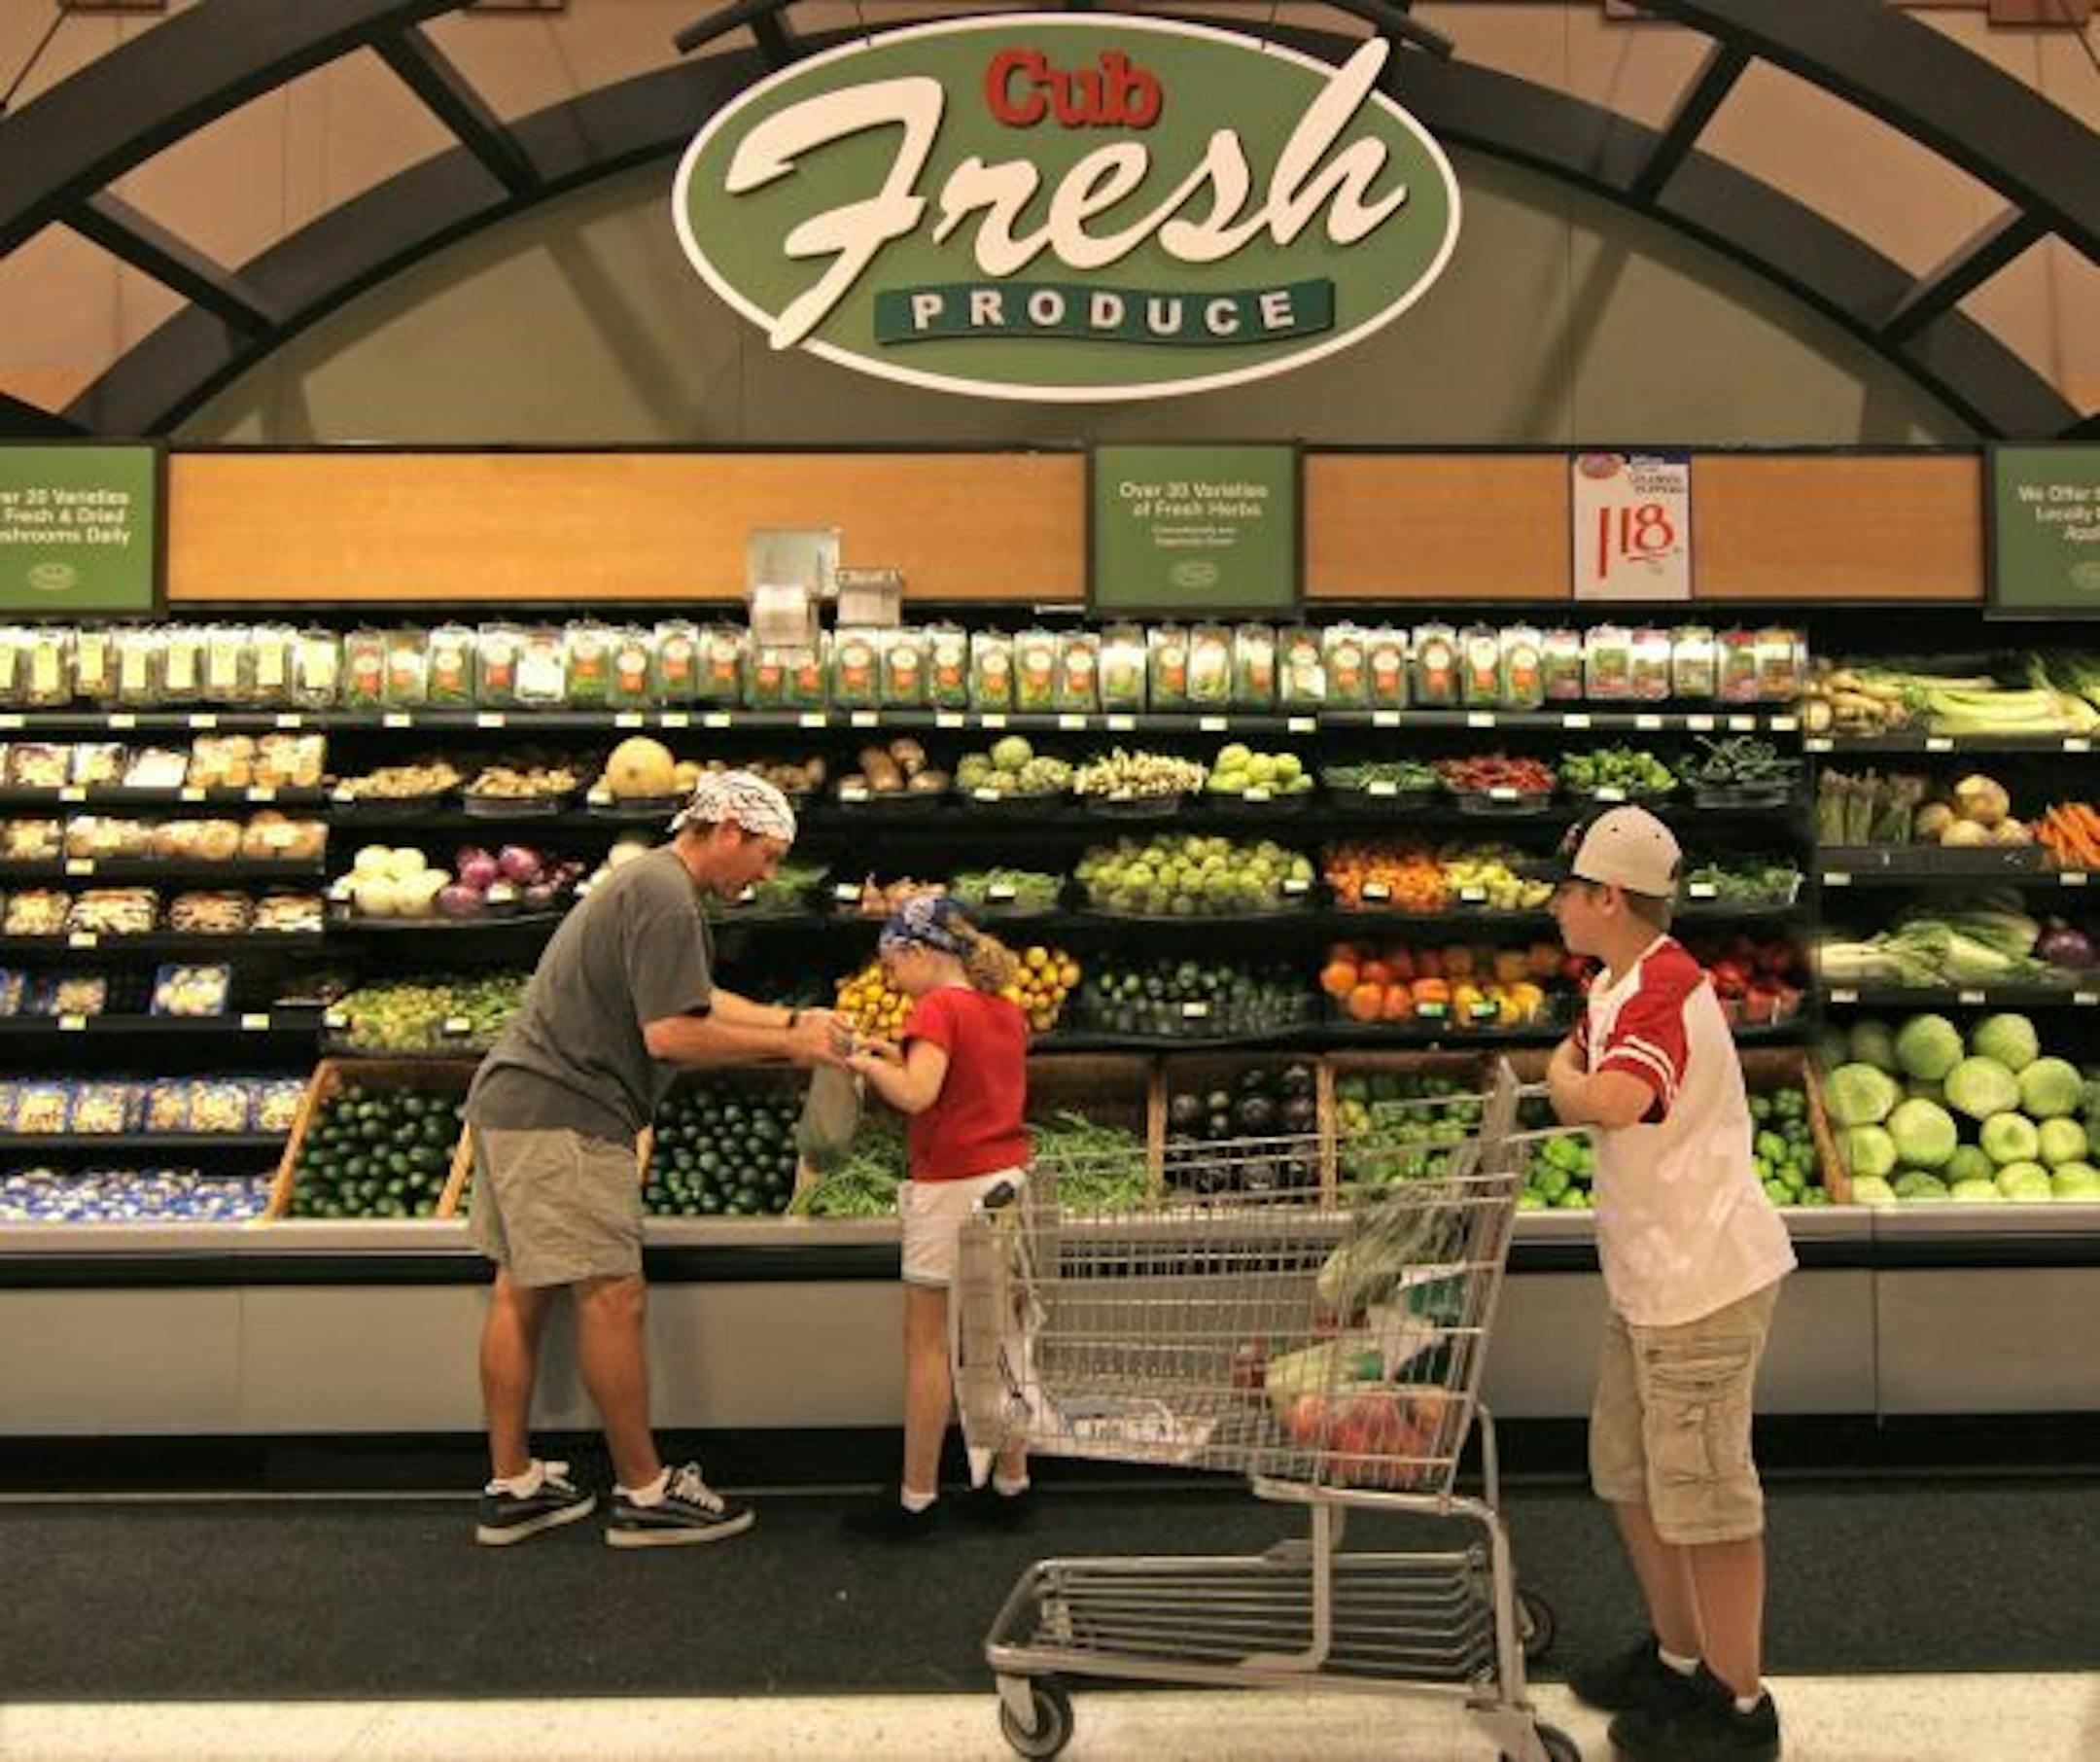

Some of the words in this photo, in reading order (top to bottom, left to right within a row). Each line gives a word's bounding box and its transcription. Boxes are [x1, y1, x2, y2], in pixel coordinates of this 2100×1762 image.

[984, 49, 1163, 129] Cub
[725, 36, 1408, 351] Fresh
[912, 291, 1296, 335] PRODUCE
[0, 492, 19, 504] er
[52, 489, 129, 505] Varieties
[1119, 481, 1162, 498] Over
[1194, 481, 1268, 498] Varieties
[5, 507, 54, 523] Fresh
[77, 507, 125, 523] Dried
[1133, 500, 1150, 516] of
[1155, 499, 1203, 516] Fresh
[1208, 500, 1263, 516] Herbs
[87, 526, 131, 547] Daily
